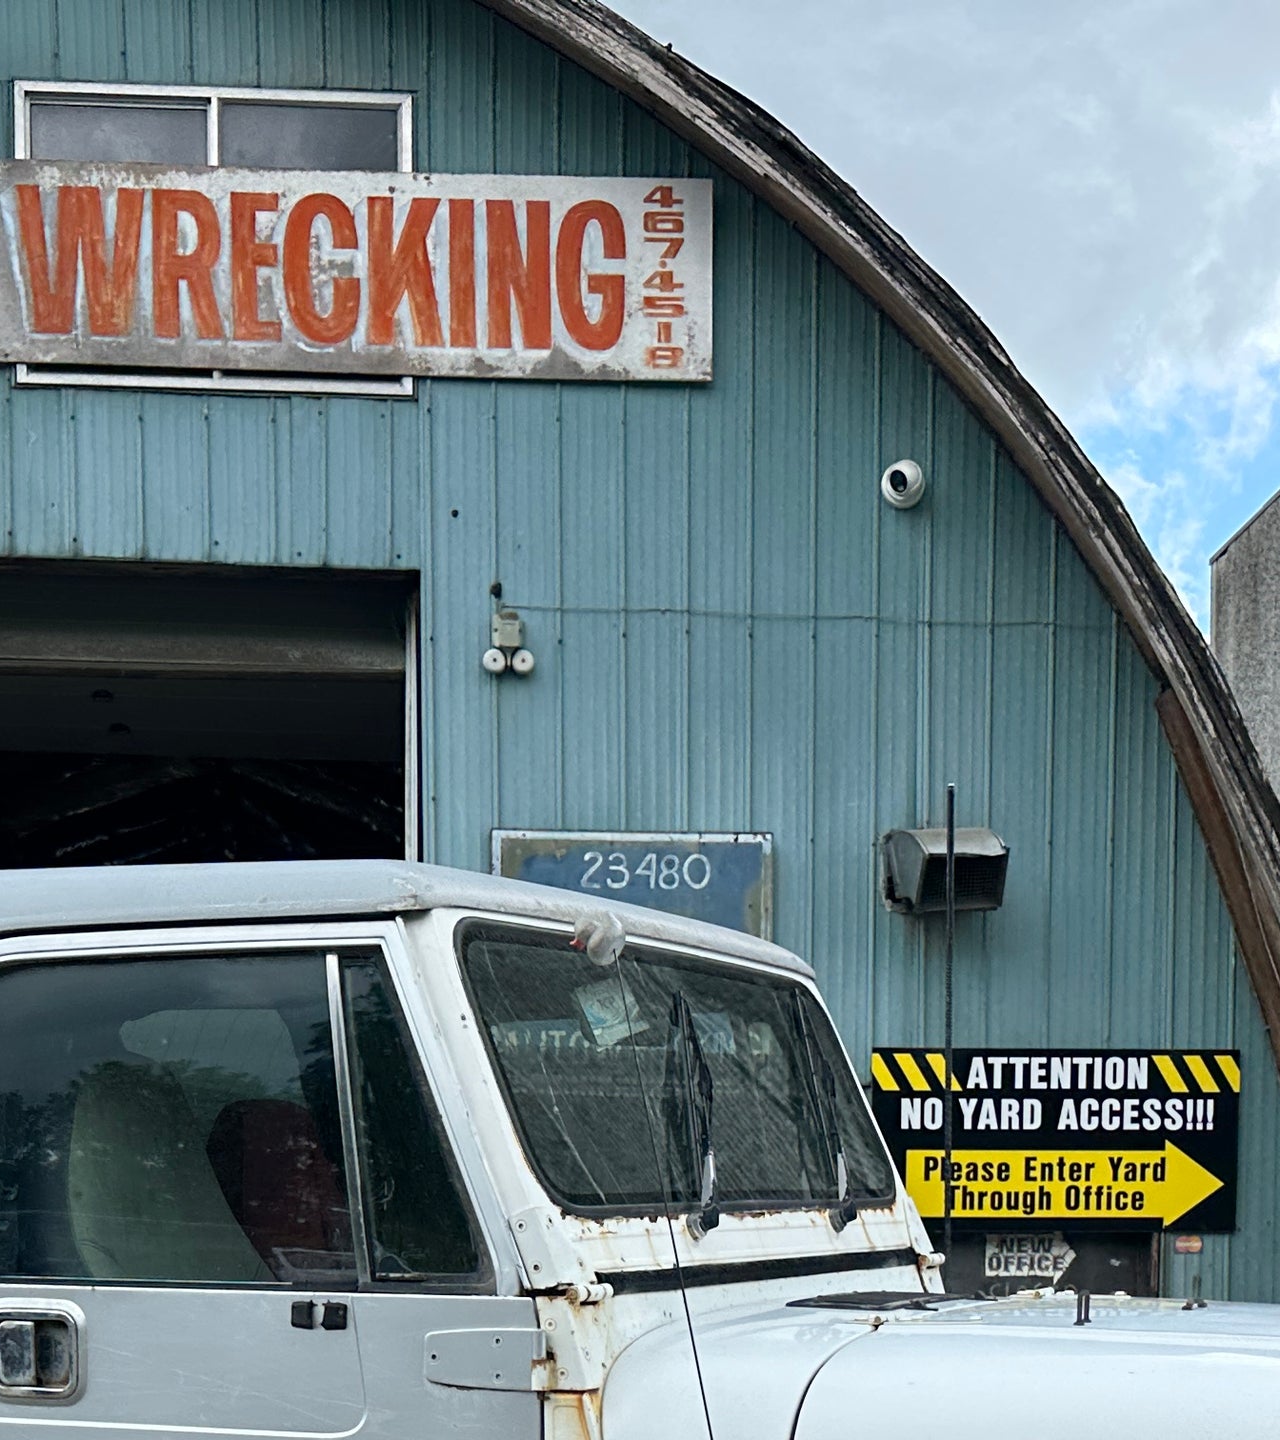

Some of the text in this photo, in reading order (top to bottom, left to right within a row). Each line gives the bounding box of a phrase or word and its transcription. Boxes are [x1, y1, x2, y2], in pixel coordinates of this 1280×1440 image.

[12, 183, 628, 352] WRECKING
[580, 851, 712, 890] 23480
[966, 1056, 1149, 1091] ATTENTION
[900, 1097, 1215, 1131] NO YARD ACCESS!!!
[1023, 1156, 1096, 1182] Enter
[1109, 1156, 1166, 1182] Yard
[948, 1185, 1145, 1215] Through Office
[998, 1236, 1054, 1253] NEW
[987, 1254, 1066, 1272] OFFICE
